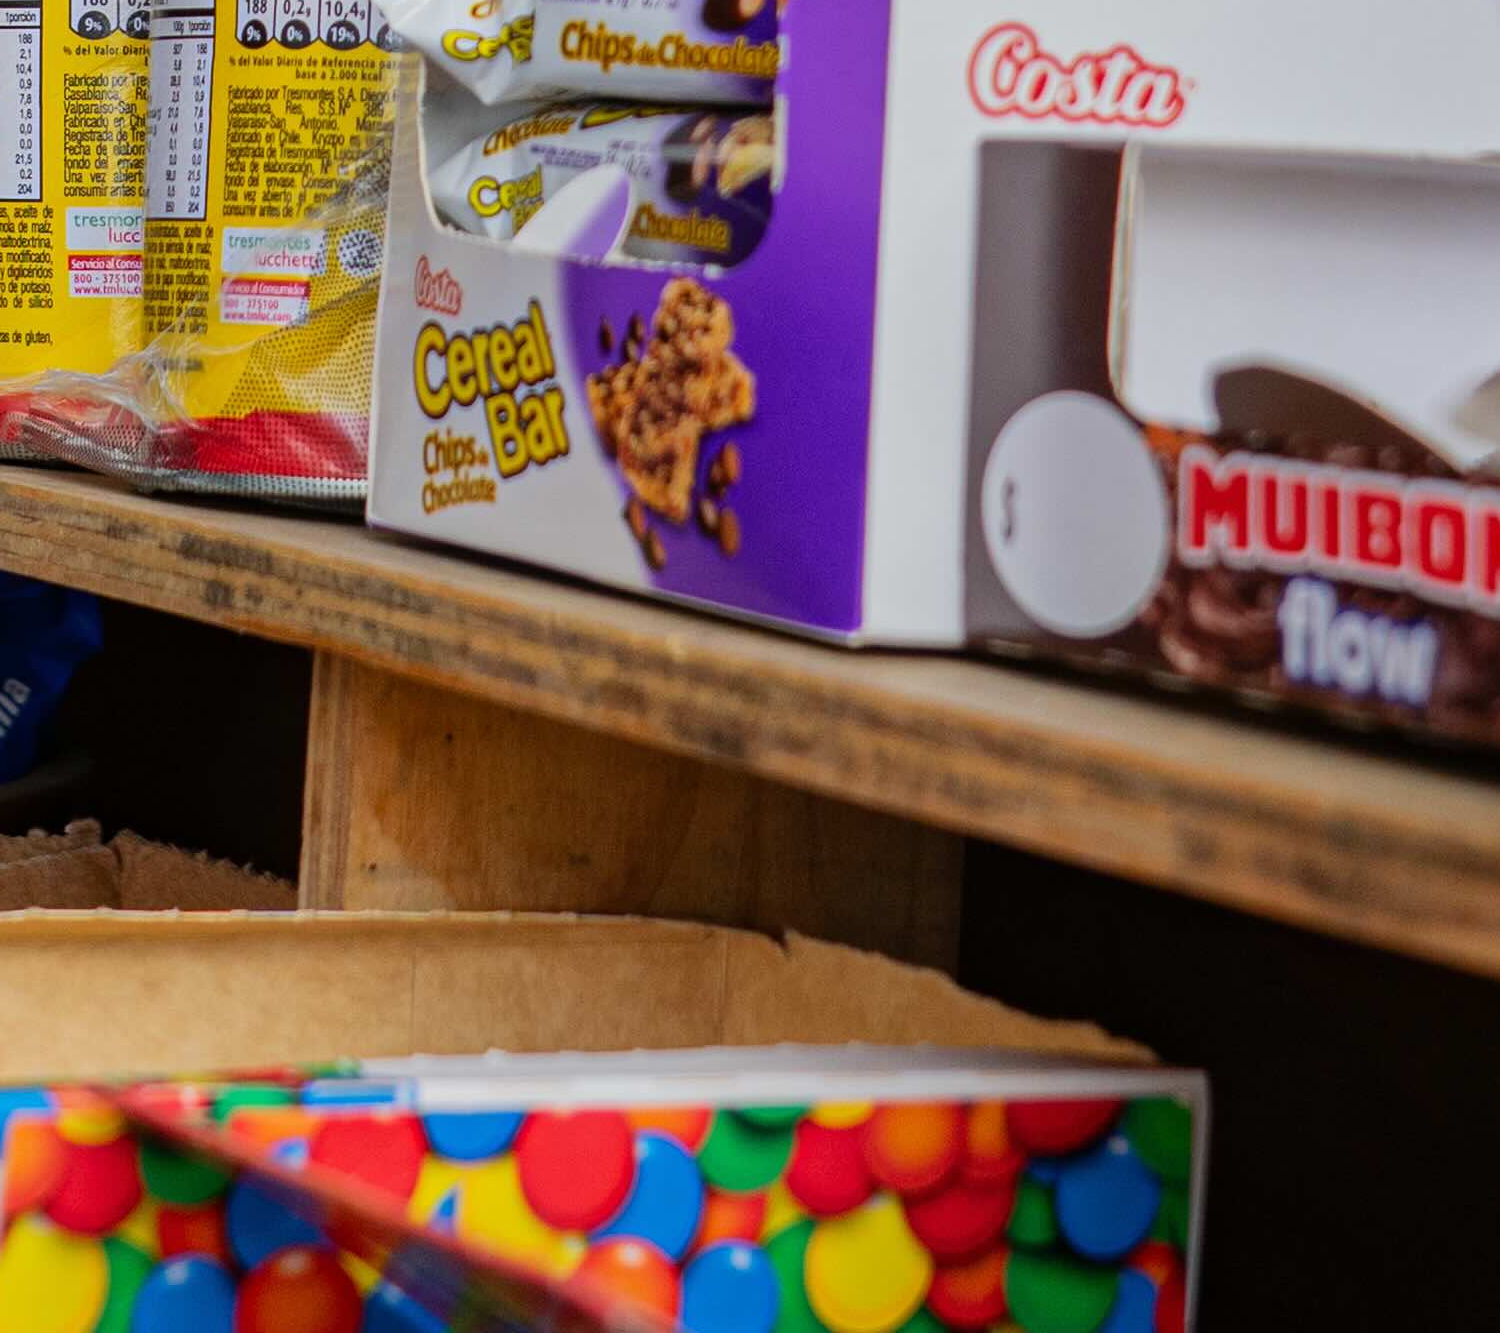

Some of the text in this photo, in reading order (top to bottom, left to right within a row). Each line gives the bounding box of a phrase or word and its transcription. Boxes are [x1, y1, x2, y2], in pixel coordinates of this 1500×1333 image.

[283, 0, 311, 16] 0,2g
[326, 1, 365, 21] 10,4g
[84, 18, 102, 31] 9%
[331, 26, 354, 42] 19%
[76, 46, 119, 56] del Valor
[560, 19, 637, 73] Chips
[658, 33, 780, 78] Chocolate
[238, 56, 377, 70] del Valor Diario de Referencia
[64, 74, 109, 87] Fabricado
[296, 69, 357, 80] base 2.000
[969, 21, 1186, 128] Costa
[64, 115, 109, 129] Fabricado
[64, 144, 90, 155] Fecha
[64, 157, 89, 170] fondo
[64, 172, 82, 183] Una
[64, 185, 107, 197] consumir
[71, 258, 105, 269] Servicio
[74, 273, 140, 283] 800 375100
[414, 296, 556, 419] Cereal
[485, 386, 570, 478] Bar
[423, 429, 476, 477] Chips
[1277, 575, 1443, 706] flow
